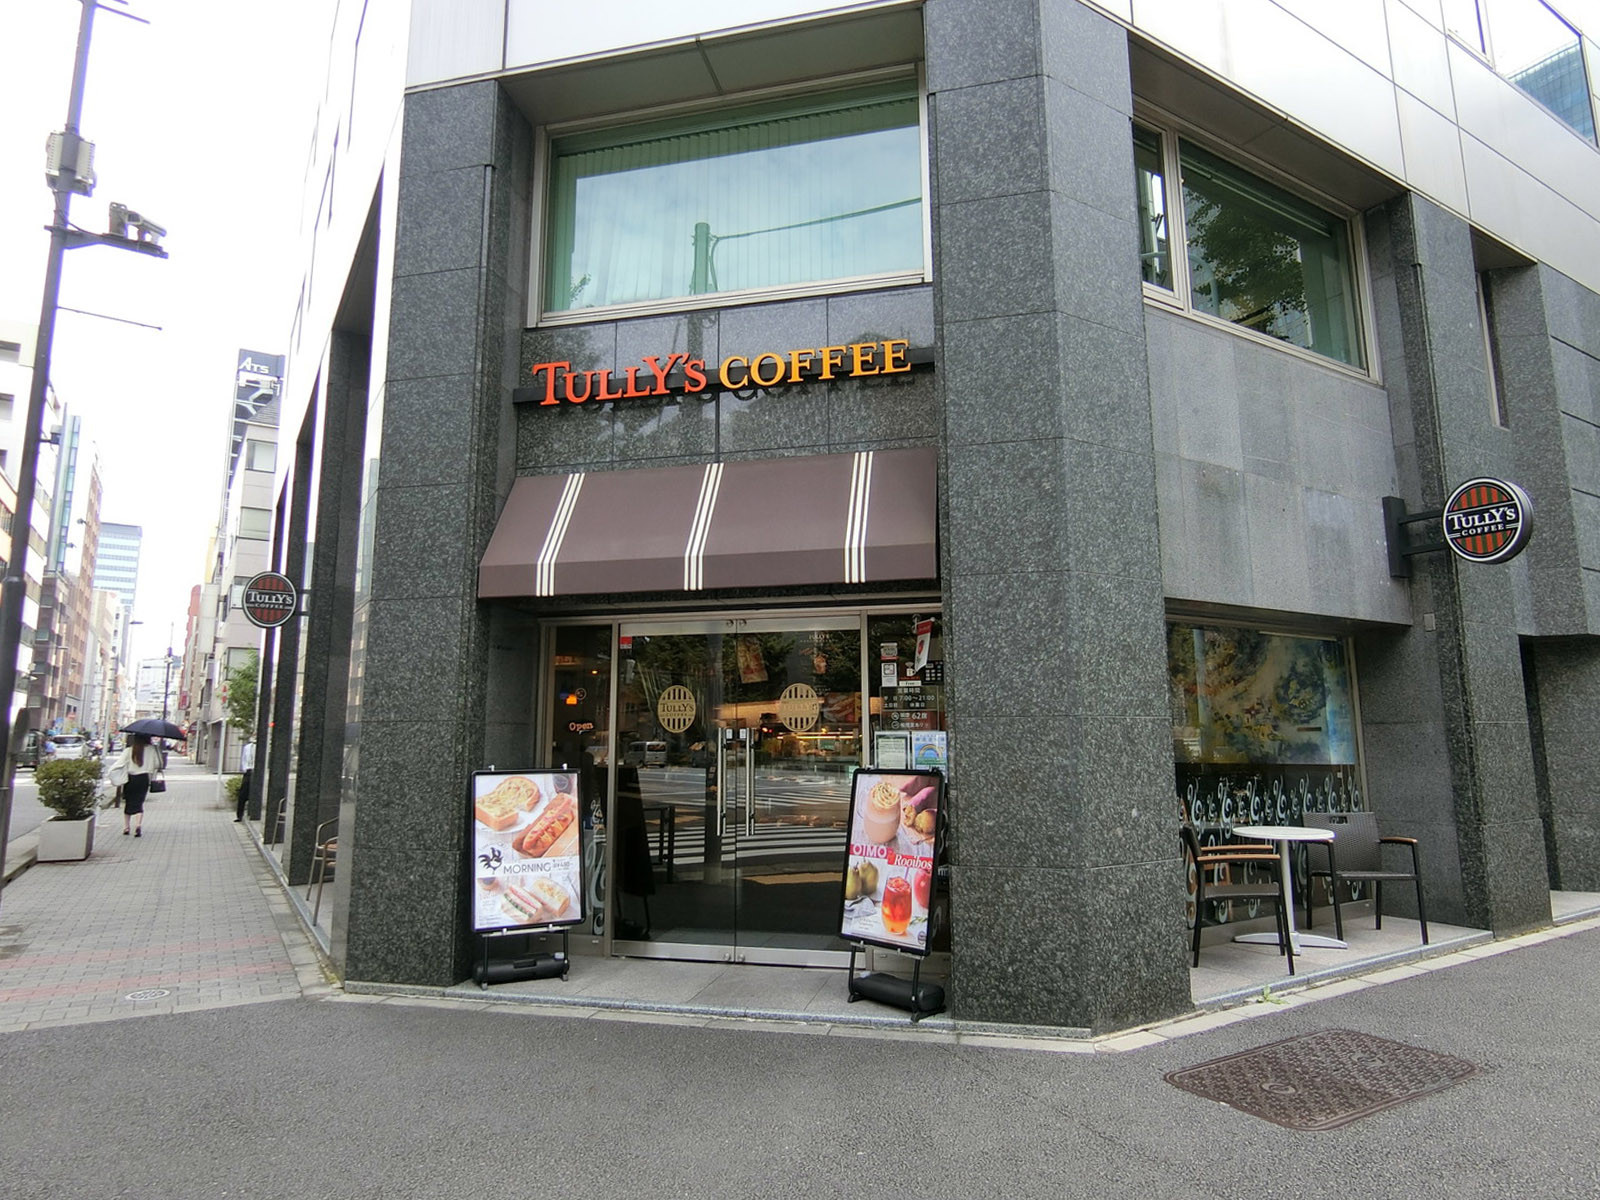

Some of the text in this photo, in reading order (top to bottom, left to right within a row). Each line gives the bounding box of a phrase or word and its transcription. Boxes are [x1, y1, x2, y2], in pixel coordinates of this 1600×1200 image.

[532, 339, 912, 406] TULLY'S COFFEE
[1448, 507, 1516, 530] TULLY'S
[1461, 524, 1504, 536] COFFEE
[248, 591, 293, 605] TULLY'S
[569, 721, 594, 732] Open
[853, 844, 888, 859] OIMO
[503, 862, 551, 874] MORNING
[894, 854, 933, 869] Rooibos
